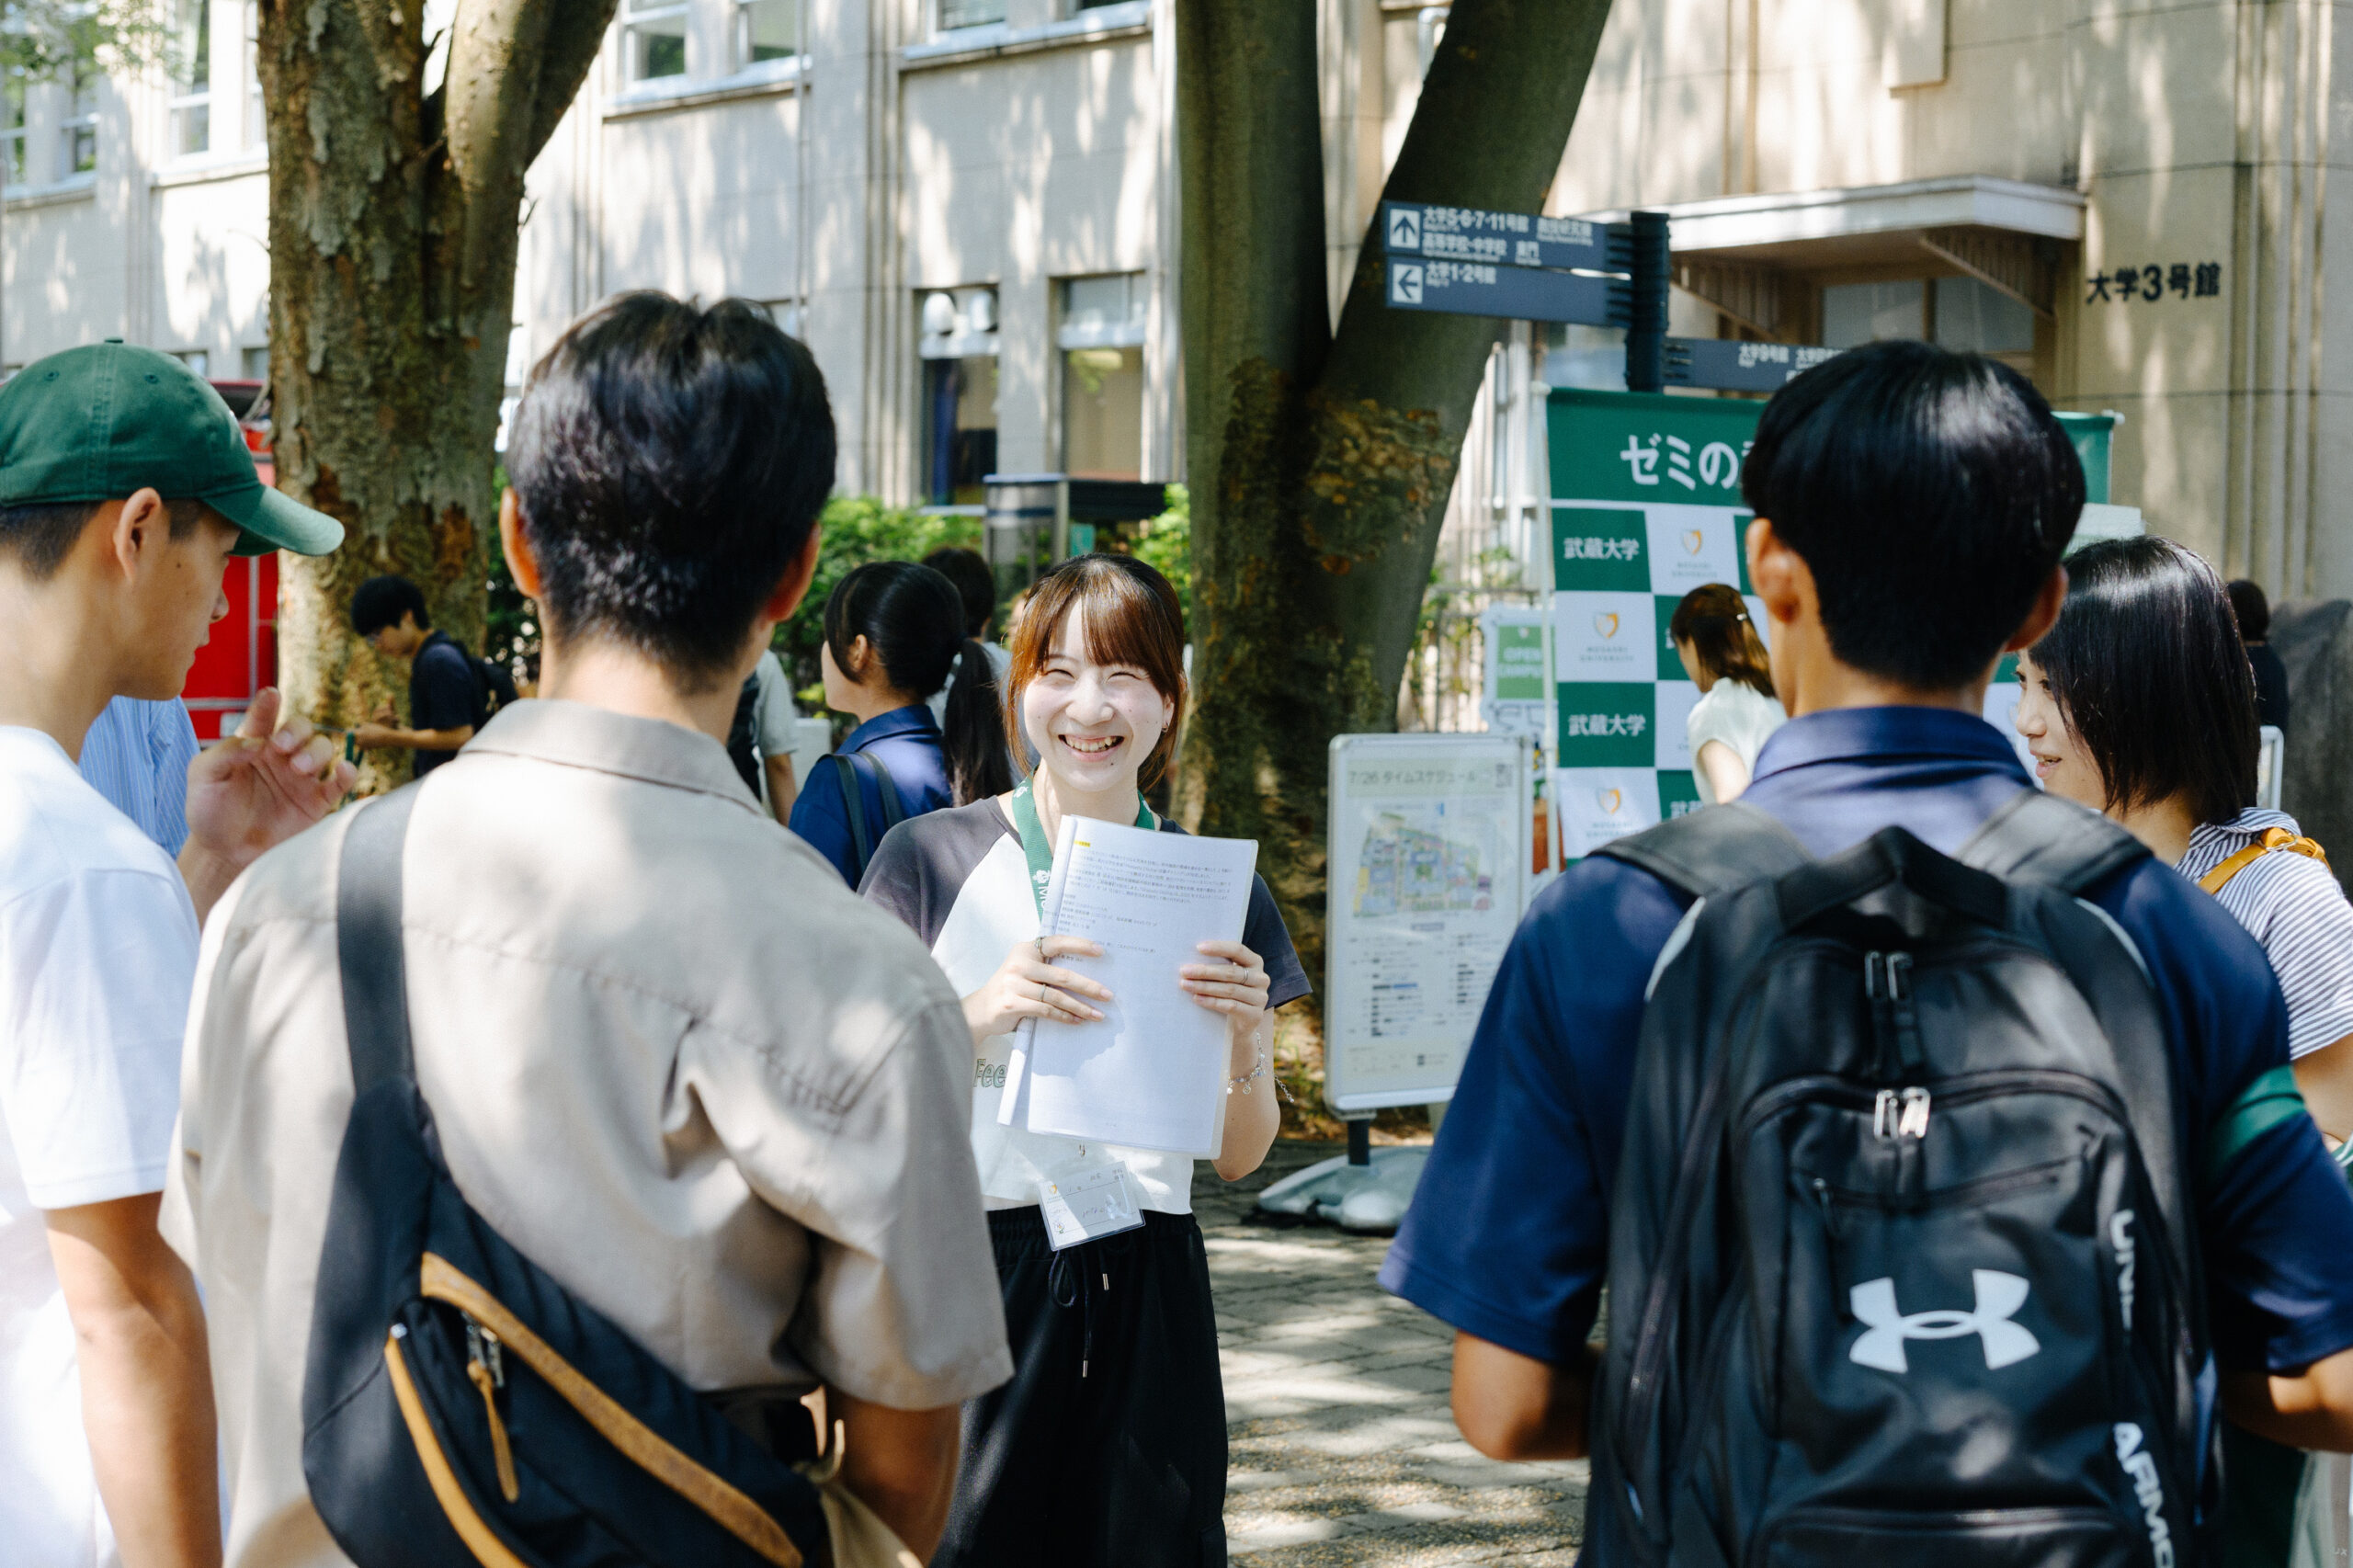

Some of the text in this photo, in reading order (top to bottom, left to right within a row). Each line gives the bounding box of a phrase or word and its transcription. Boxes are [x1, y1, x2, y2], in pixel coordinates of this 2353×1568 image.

[2086, 261, 2222, 305] 大学3号館
[1620, 433, 1755, 491] ゼミの
[1563, 536, 1641, 562] 武蔵大学
[1567, 713, 1647, 737] 武蔵大学
